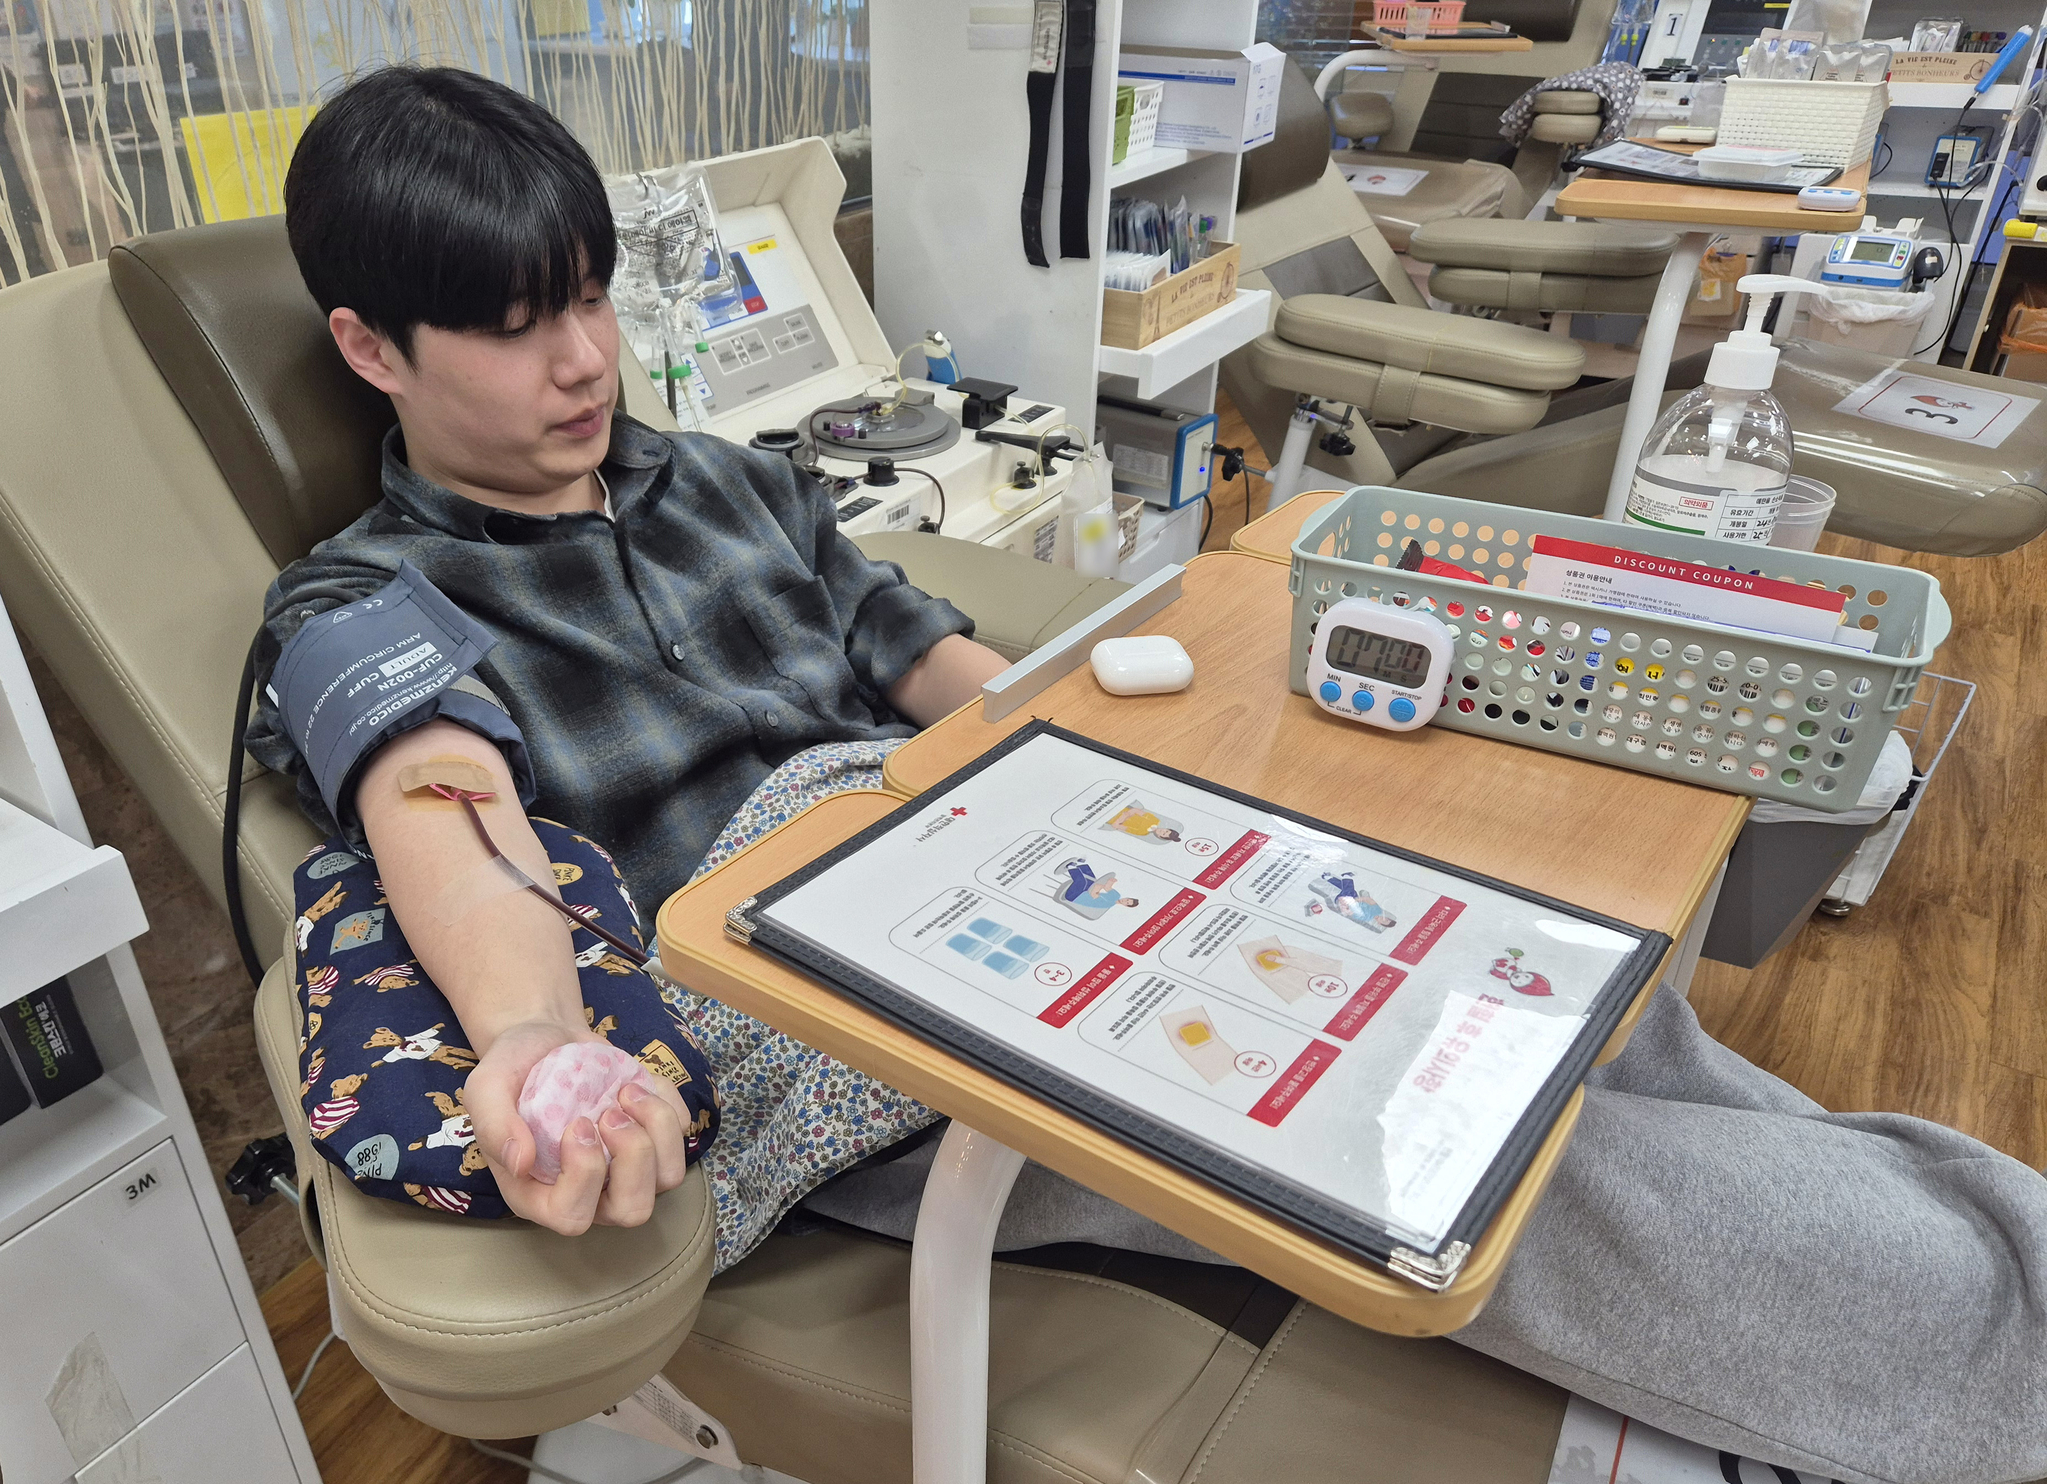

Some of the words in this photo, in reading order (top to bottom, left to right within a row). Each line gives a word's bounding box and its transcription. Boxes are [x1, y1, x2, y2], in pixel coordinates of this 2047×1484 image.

[1934, 56, 1958, 65] PLEINE
[1905, 407, 1958, 425] 3
[1566, 569, 1586, 579] 상품권
[1587, 573, 1613, 584] 이용안내
[1614, 555, 1687, 577] DISCOUNT
[1693, 570, 1754, 590] COUPON
[398, 632, 421, 649] ARM
[390, 647, 427, 671] ADULT
[313, 646, 395, 715] CIRCUMFERENCE
[377, 653, 443, 692] CUF-002N
[1327, 673, 1341, 682] MIN
[347, 672, 380, 698] CUFF
[1358, 682, 1375, 692] SEC
[1391, 690, 1422, 700] START/STOP
[1335, 706, 1352, 714] CLEAR
[912, 815, 957, 842] 대한적십자사
[26, 1019, 59, 1079] CleanSkin
[126, 1174, 156, 1200] 3M
